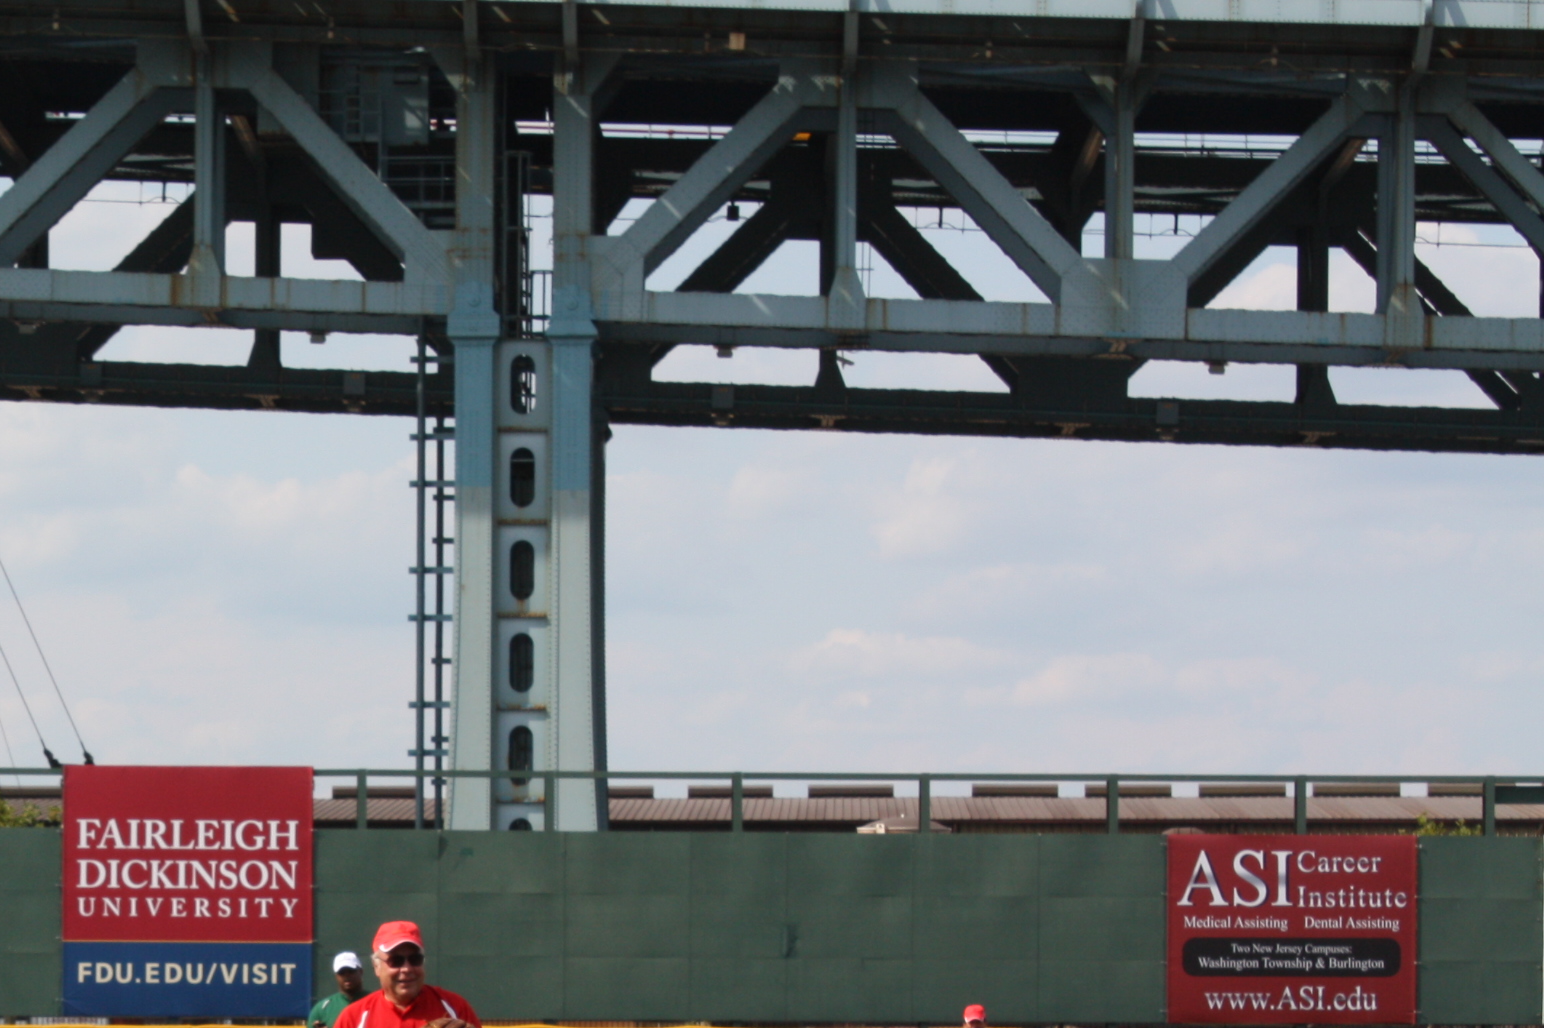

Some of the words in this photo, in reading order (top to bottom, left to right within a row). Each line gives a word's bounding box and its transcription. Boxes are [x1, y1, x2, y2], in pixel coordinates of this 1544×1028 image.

[76, 818, 299, 851] FAIRLEIGH
[76, 859, 298, 890] DICKINSON
[1177, 849, 1293, 907] ASI
[1297, 850, 1382, 873] Career
[77, 897, 299, 918] UNIVERSITY
[1297, 885, 1407, 909] Institute
[1183, 915, 1232, 929] Medical
[1234, 916, 1289, 932] Assisting
[1304, 916, 1343, 930] Dental
[1345, 916, 1400, 932] Assisting
[1230, 943, 1251, 954] Two
[1252, 943, 1274, 954] New
[1275, 943, 1302, 957] Jersey
[1304, 944, 1352, 957] Campuses:
[77, 962, 297, 985] FDU.EDU/VISIT
[1198, 957, 1259, 972] Washington
[1261, 957, 1313, 972] Township
[1315, 958, 1326, 969] &
[1328, 957, 1385, 972] Burlington
[1205, 986, 1378, 1011] www.ASI.edu
